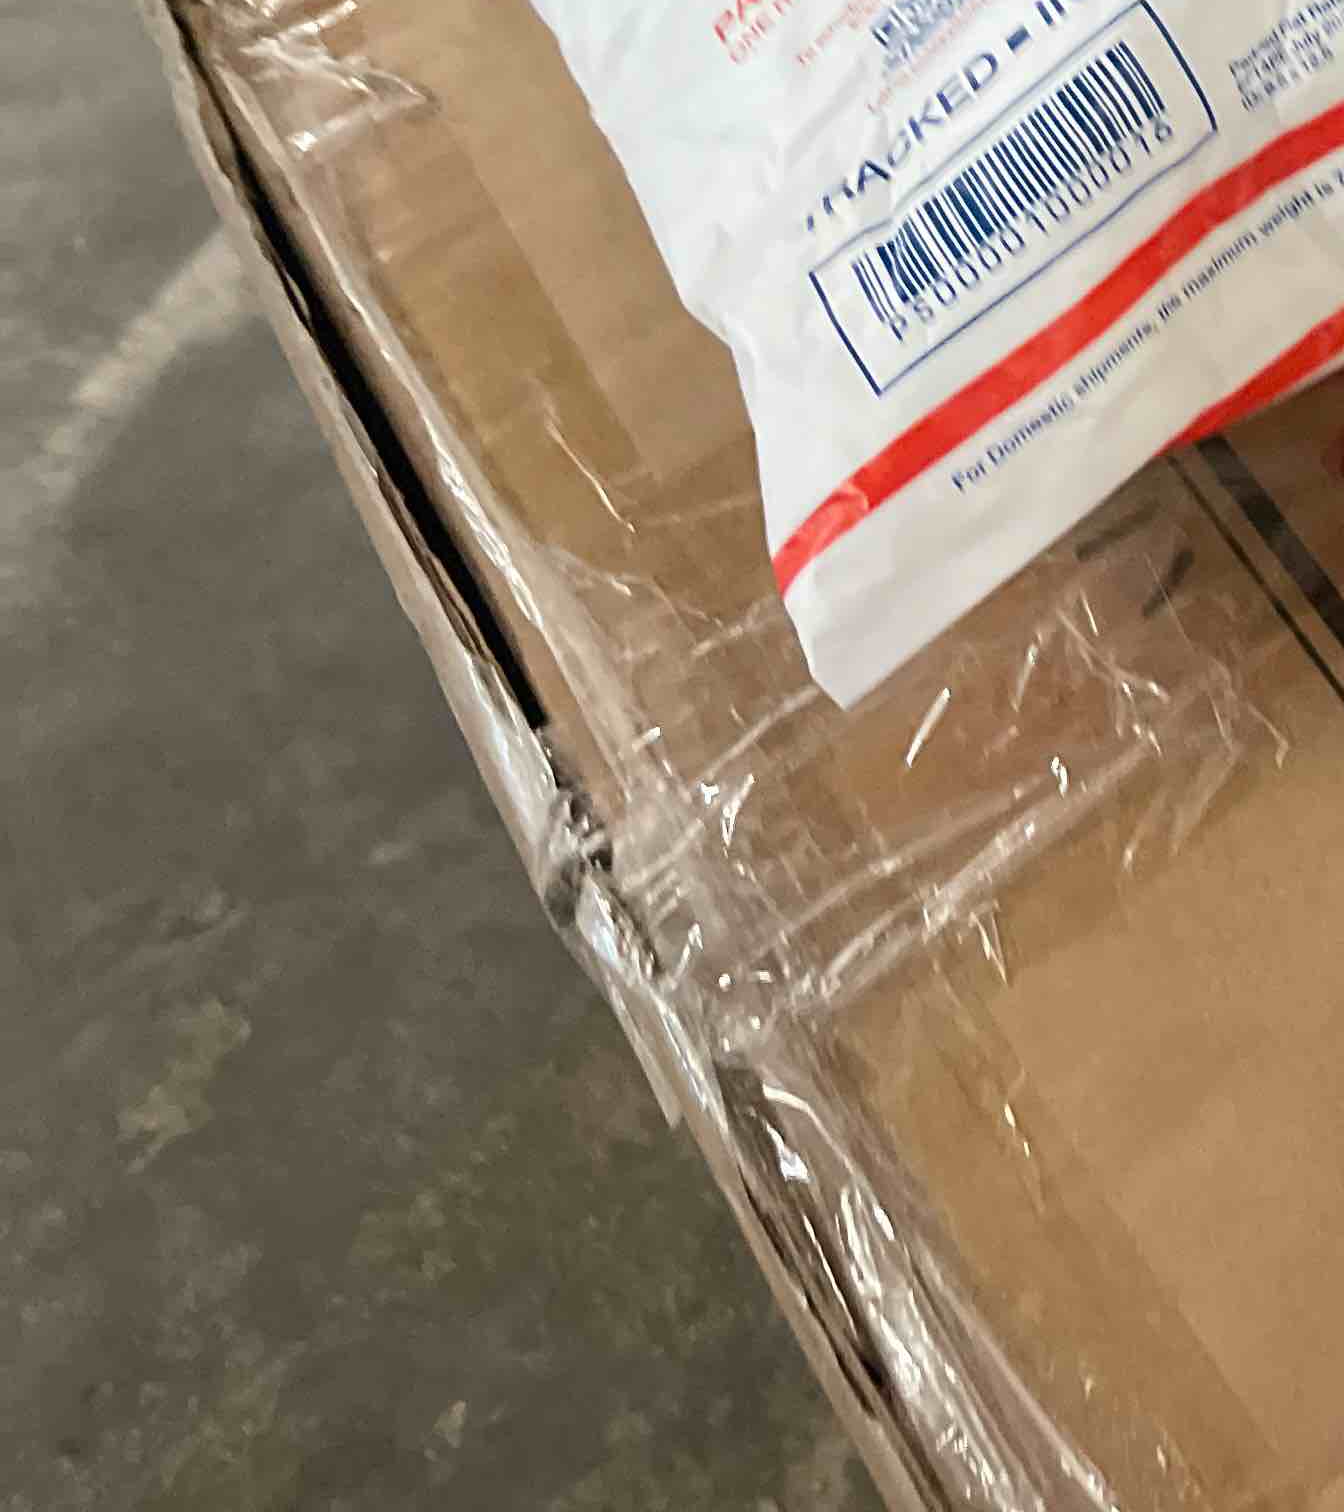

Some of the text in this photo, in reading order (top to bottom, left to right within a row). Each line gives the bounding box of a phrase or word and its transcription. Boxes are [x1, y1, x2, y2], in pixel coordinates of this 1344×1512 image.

[726, 11, 777, 66] ONE
[884, 119, 1175, 343] PS00001000016
[951, 457, 987, 494] For
[987, 390, 1076, 466] Domestic
[1072, 316, 1160, 398] shipments,
[1157, 293, 1184, 323] the
[1182, 228, 1260, 302] maximum
[1257, 186, 1317, 240] weight
[1314, 179, 1335, 200] is
